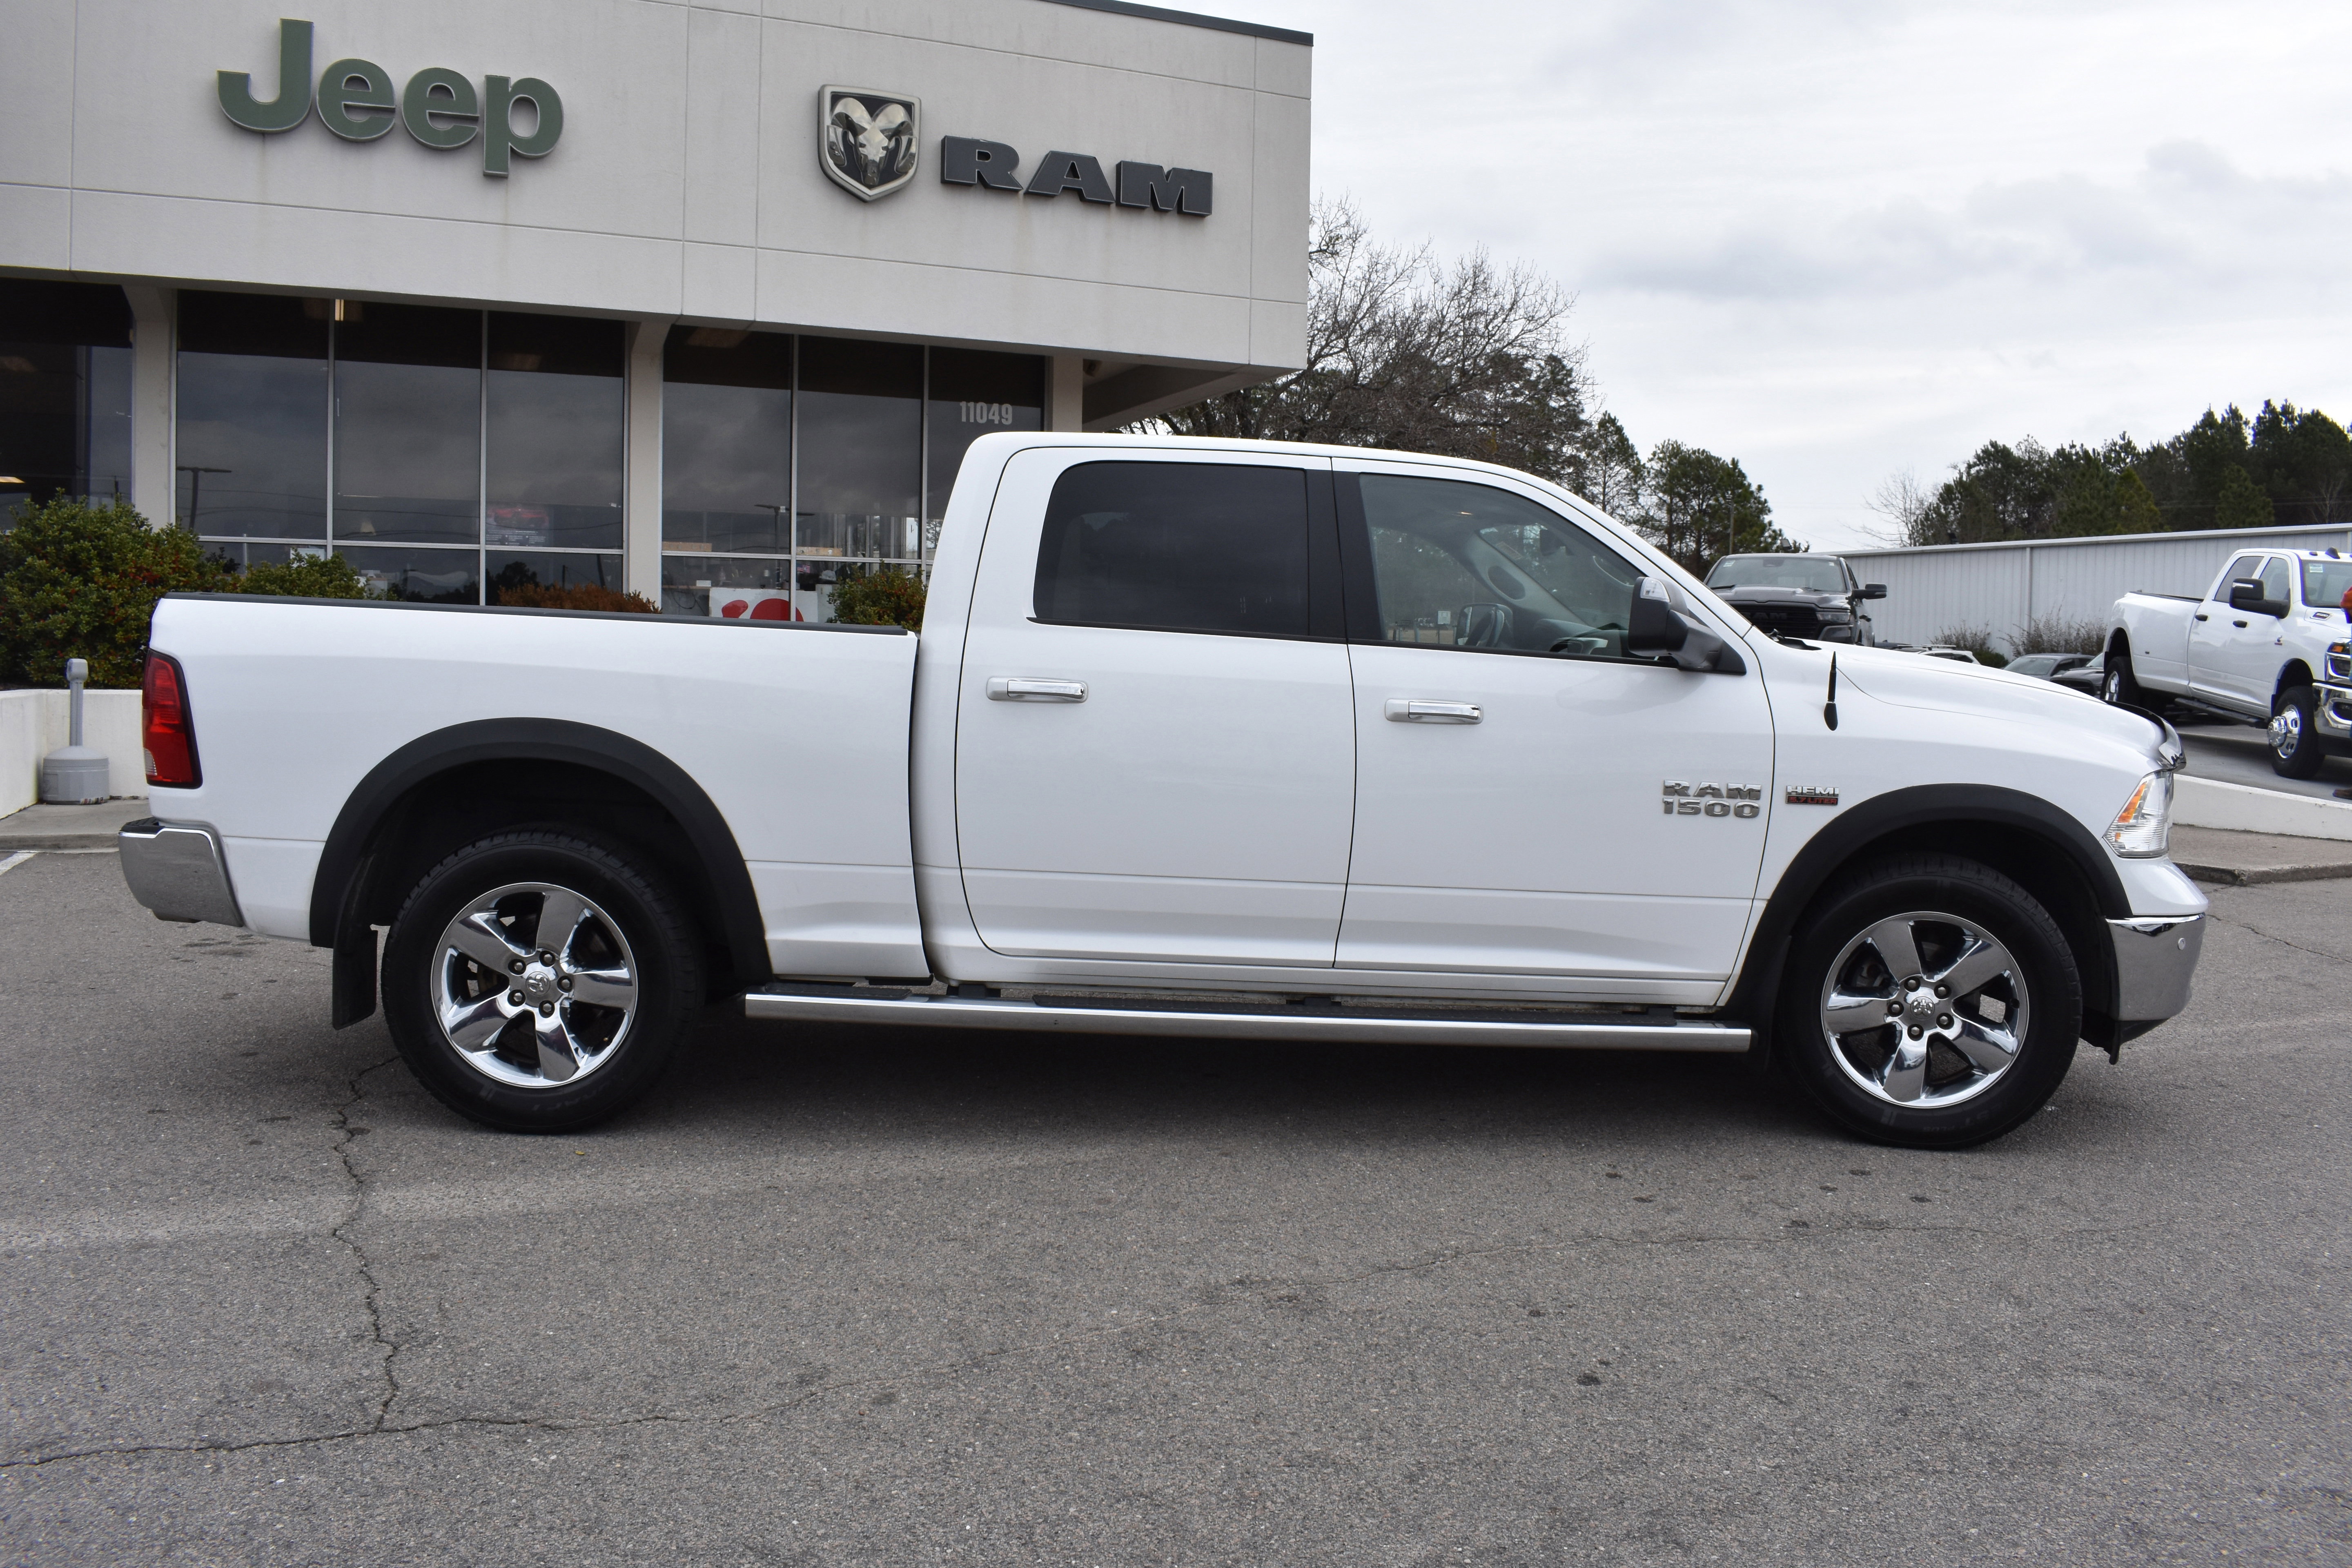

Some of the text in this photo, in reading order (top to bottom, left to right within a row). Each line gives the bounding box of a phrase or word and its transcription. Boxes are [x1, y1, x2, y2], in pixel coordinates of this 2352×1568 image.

[216, 18, 564, 178] Jeep
[940, 135, 1213, 217] RAM
[960, 401, 1013, 425] 11049
[1663, 780, 1761, 800] RAM
[1786, 786, 1839, 797] HEMI
[1662, 797, 1760, 818] 1500
